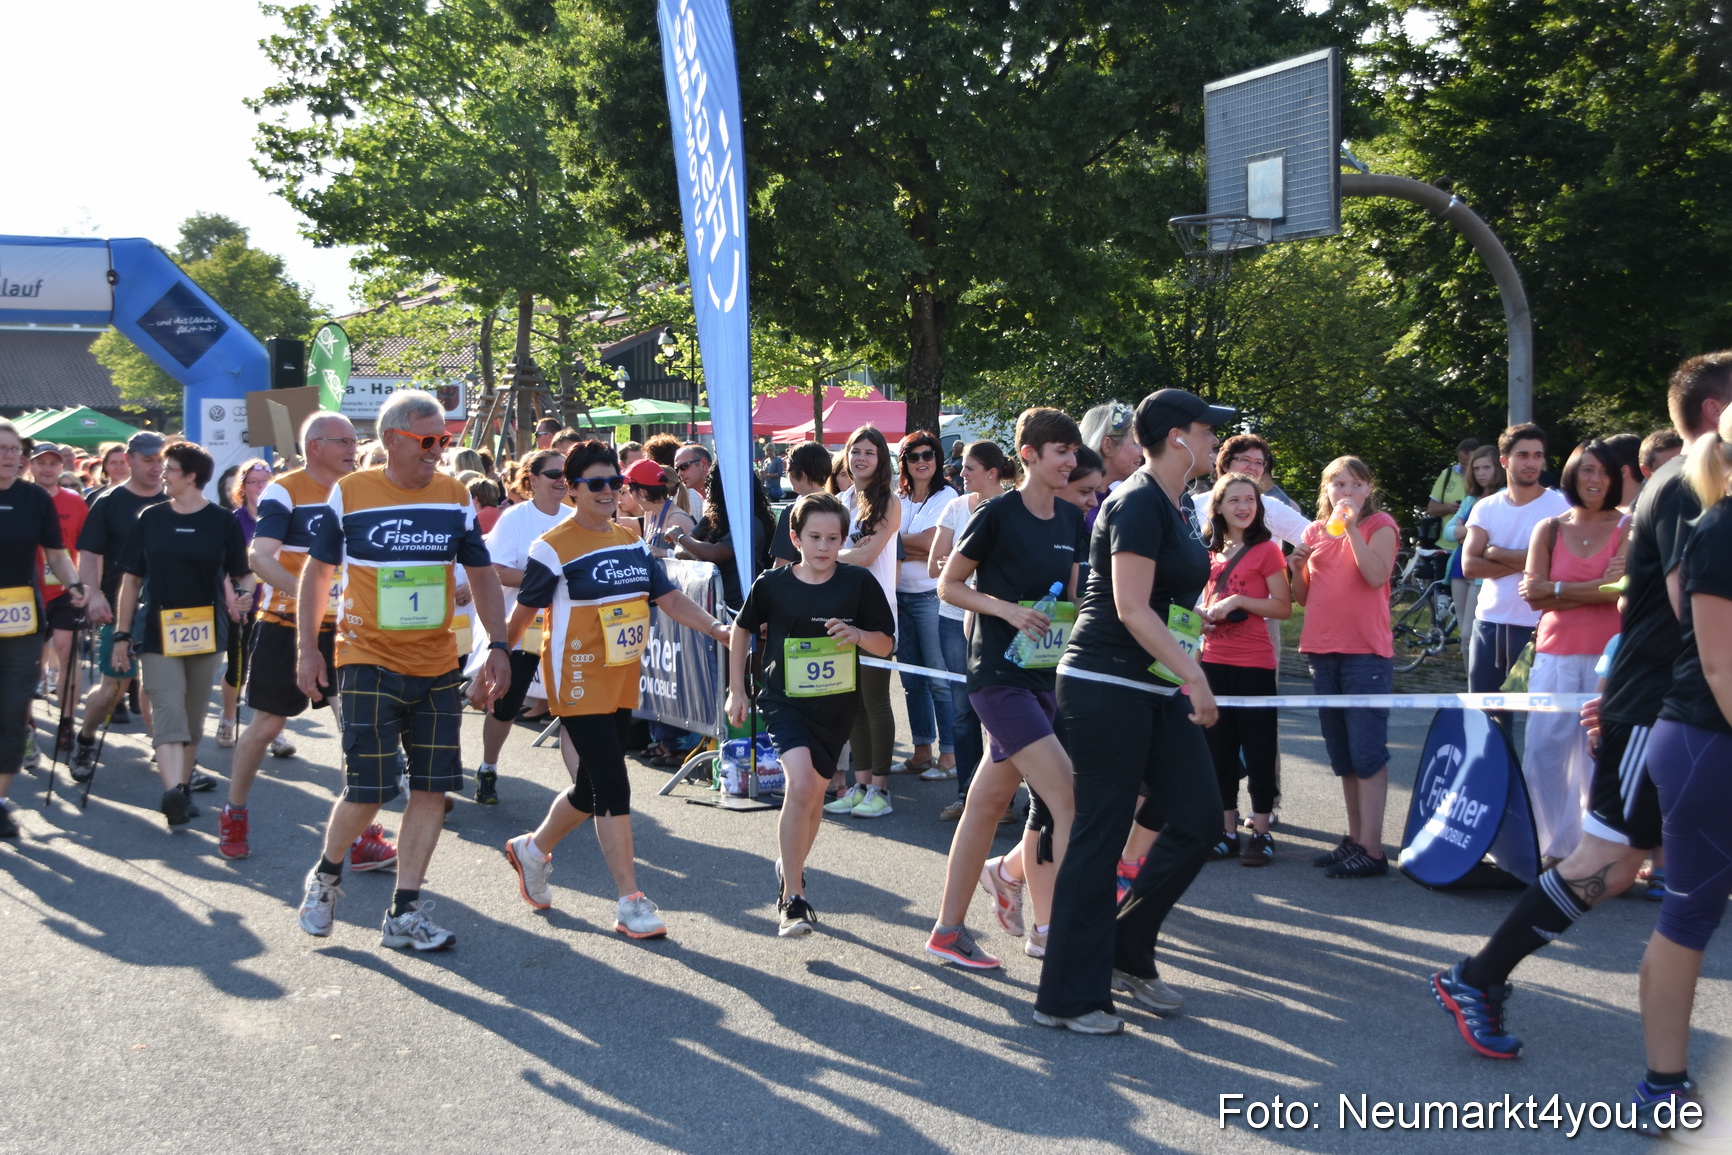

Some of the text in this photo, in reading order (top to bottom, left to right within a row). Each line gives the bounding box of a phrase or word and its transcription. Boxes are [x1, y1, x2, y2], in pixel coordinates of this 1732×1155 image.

[2, 278, 44, 297] lauf
[384, 530, 452, 544] Fischer
[605, 565, 648, 580] Fischer
[409, 591, 419, 612] 1
[170, 625, 209, 643] 1201
[617, 624, 644, 648] 438
[807, 660, 835, 681] 95
[1426, 776, 1488, 828] Fischer
